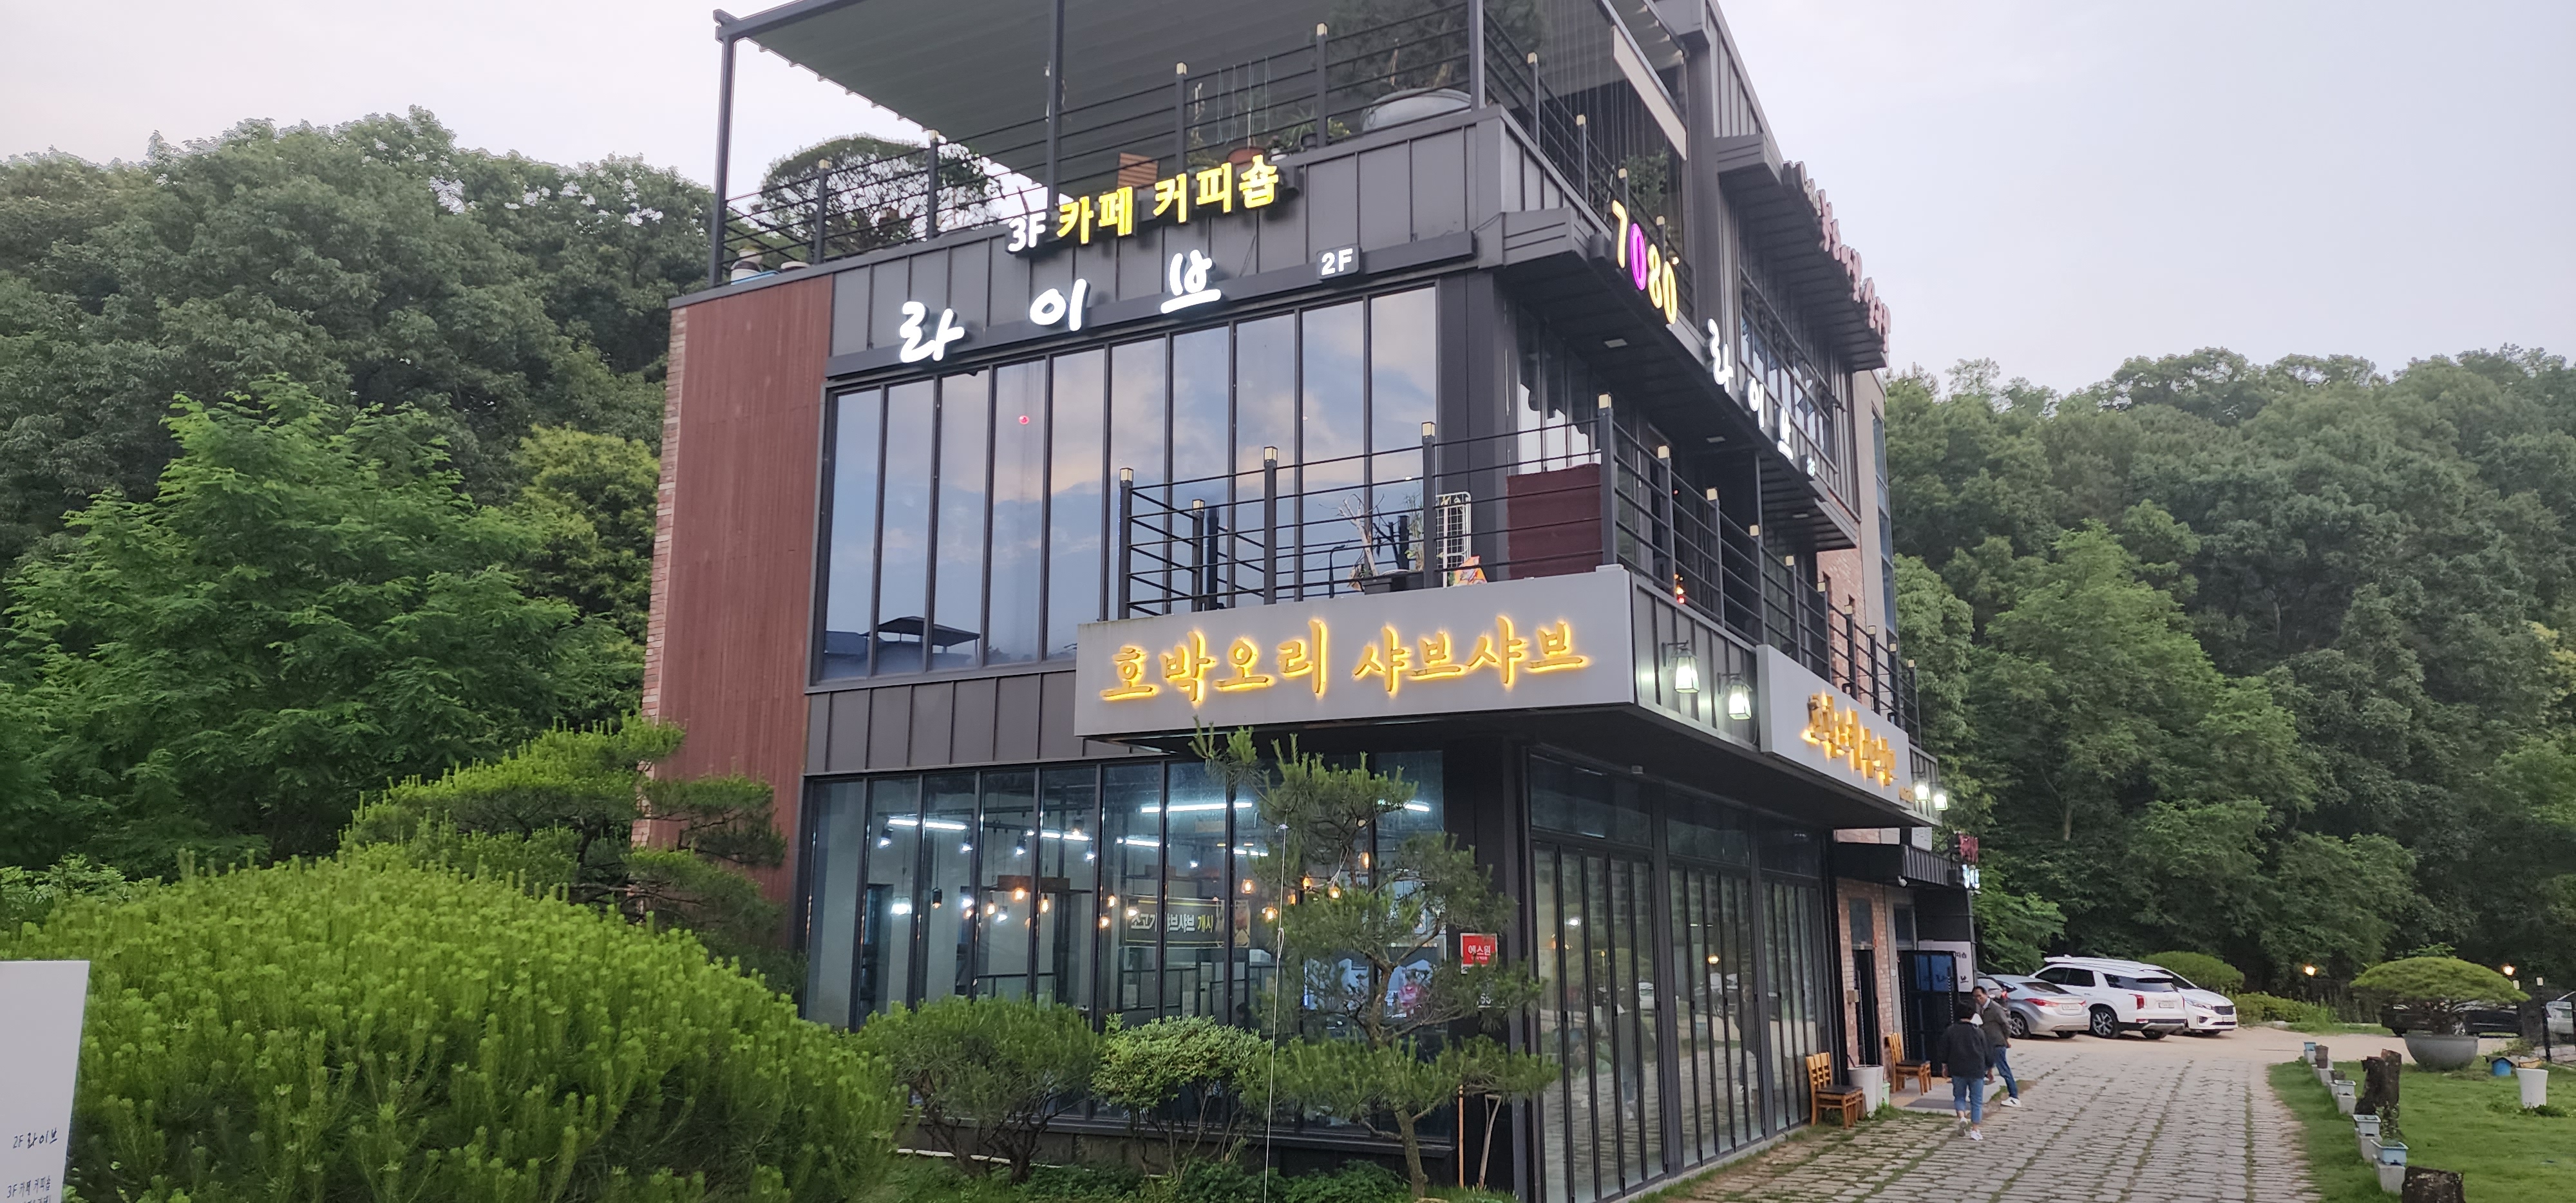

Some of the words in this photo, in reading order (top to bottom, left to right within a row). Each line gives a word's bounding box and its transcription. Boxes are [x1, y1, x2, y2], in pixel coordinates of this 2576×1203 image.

[1008, 211, 1046, 252] 3F
[1057, 185, 1133, 245] 카페
[1152, 154, 1280, 223] 커피숍
[898, 249, 1222, 364] 라이브
[1320, 247, 1354, 276] 2F
[1612, 199, 1678, 325] 7080
[1708, 318, 1794, 460] 라이브
[1101, 617, 1326, 703] 호박오리
[1352, 614, 1585, 696] 샤브샤브
[1197, 914, 1213, 933] 개시
[1468, 945, 1492, 956] 에스원
[13, 1135, 24, 1149] 2F
[7, 1184, 17, 1198] 3F
